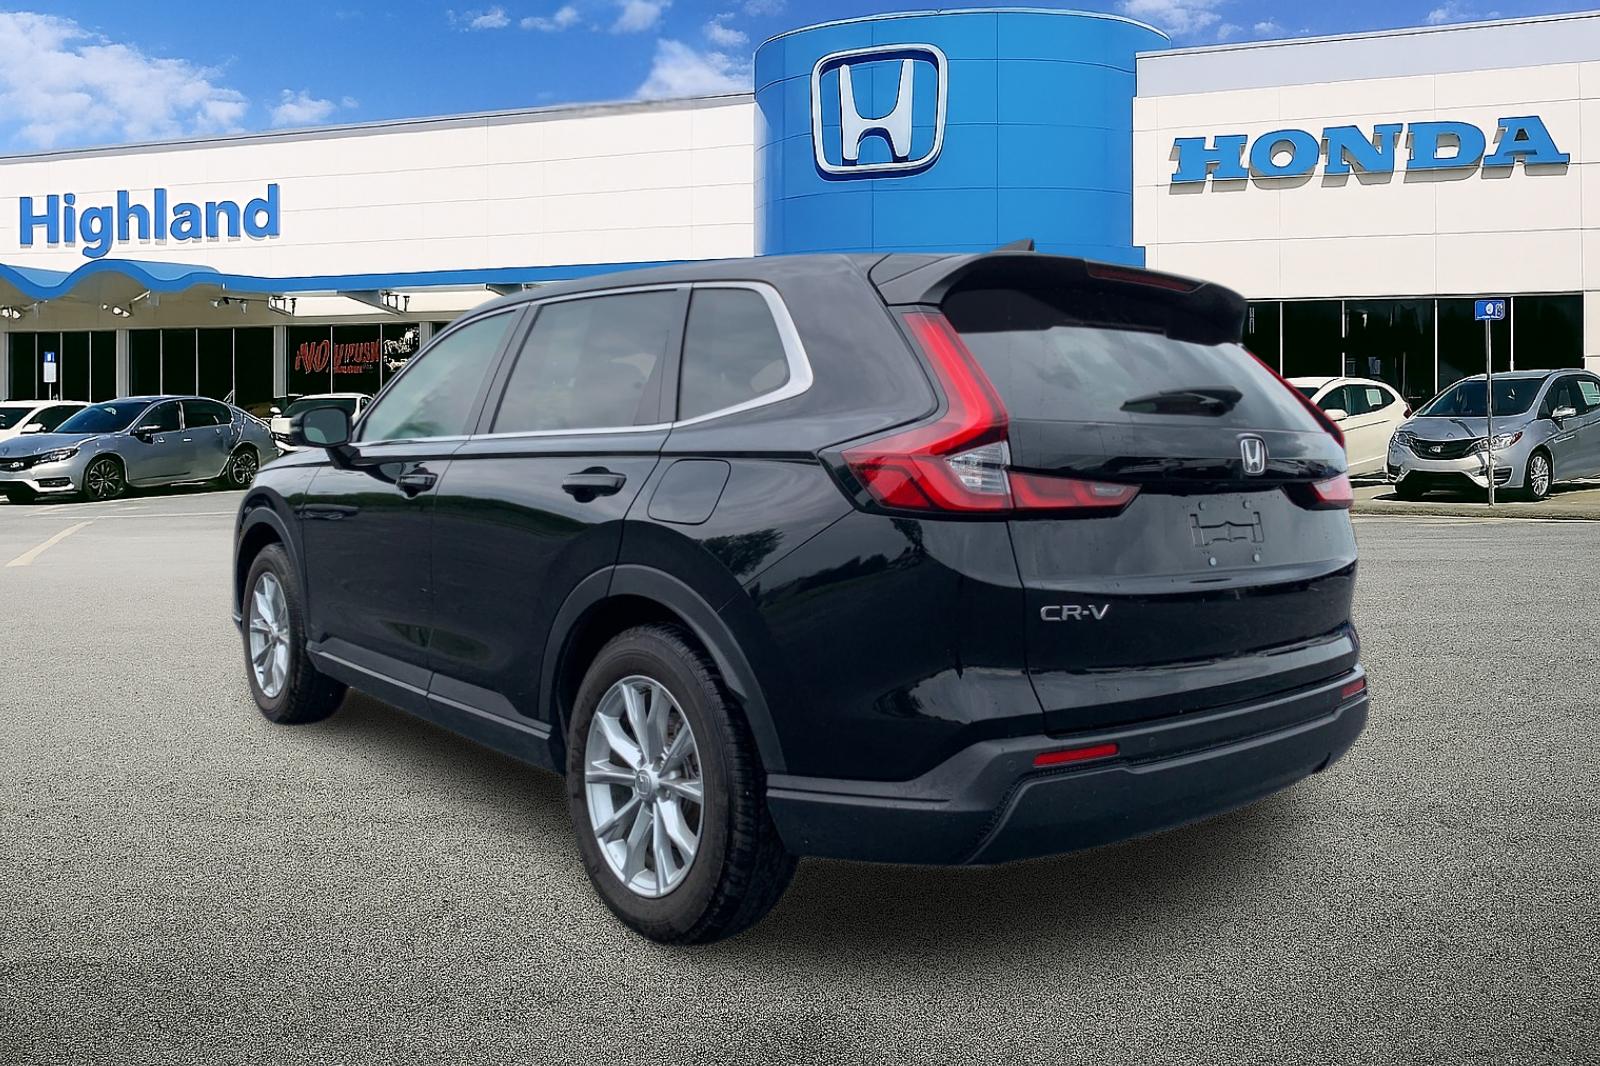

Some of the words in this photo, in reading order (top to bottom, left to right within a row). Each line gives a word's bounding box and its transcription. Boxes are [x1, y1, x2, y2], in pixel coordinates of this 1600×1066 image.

[1171, 115, 1571, 185] HONDA
[20, 183, 281, 258] Highland
[1040, 603, 1111, 622] CR-V
